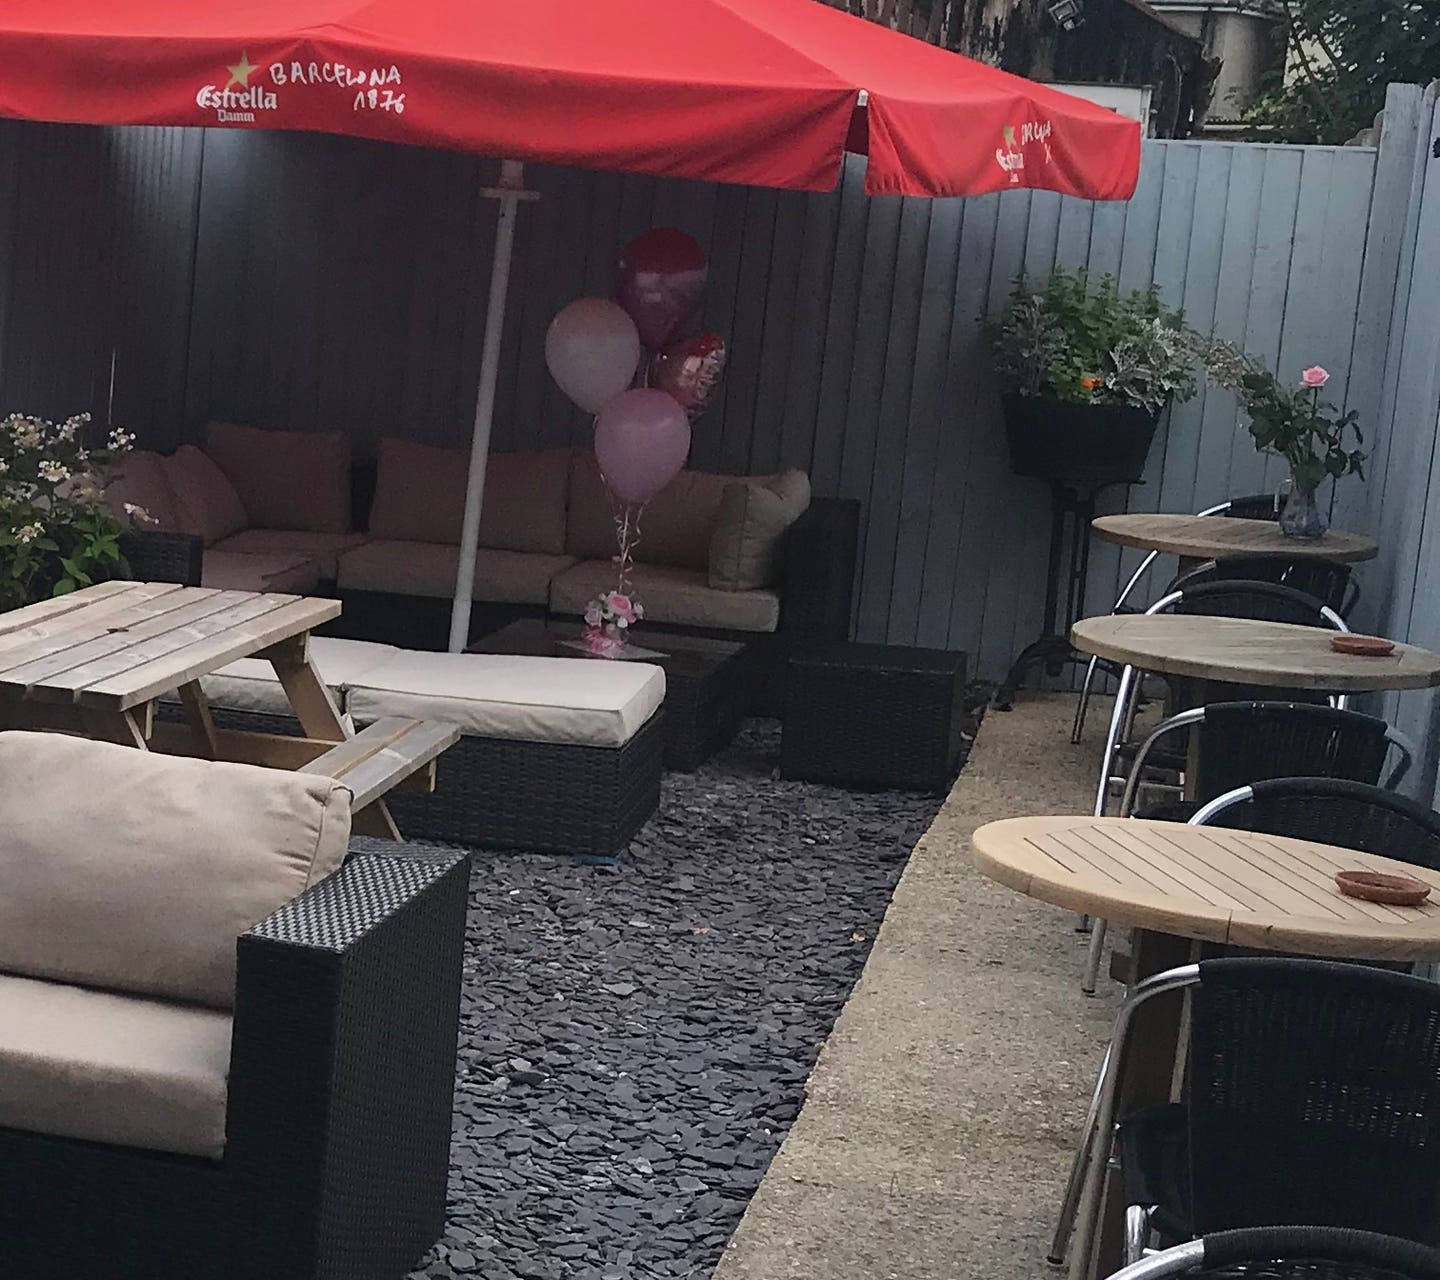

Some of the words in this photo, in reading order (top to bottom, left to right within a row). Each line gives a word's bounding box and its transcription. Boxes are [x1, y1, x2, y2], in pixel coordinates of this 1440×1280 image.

[269, 61, 402, 88] BARCELONA
[196, 84, 278, 110] Estrella
[353, 88, 405, 115] 1876
[217, 109, 255, 122] Damm
